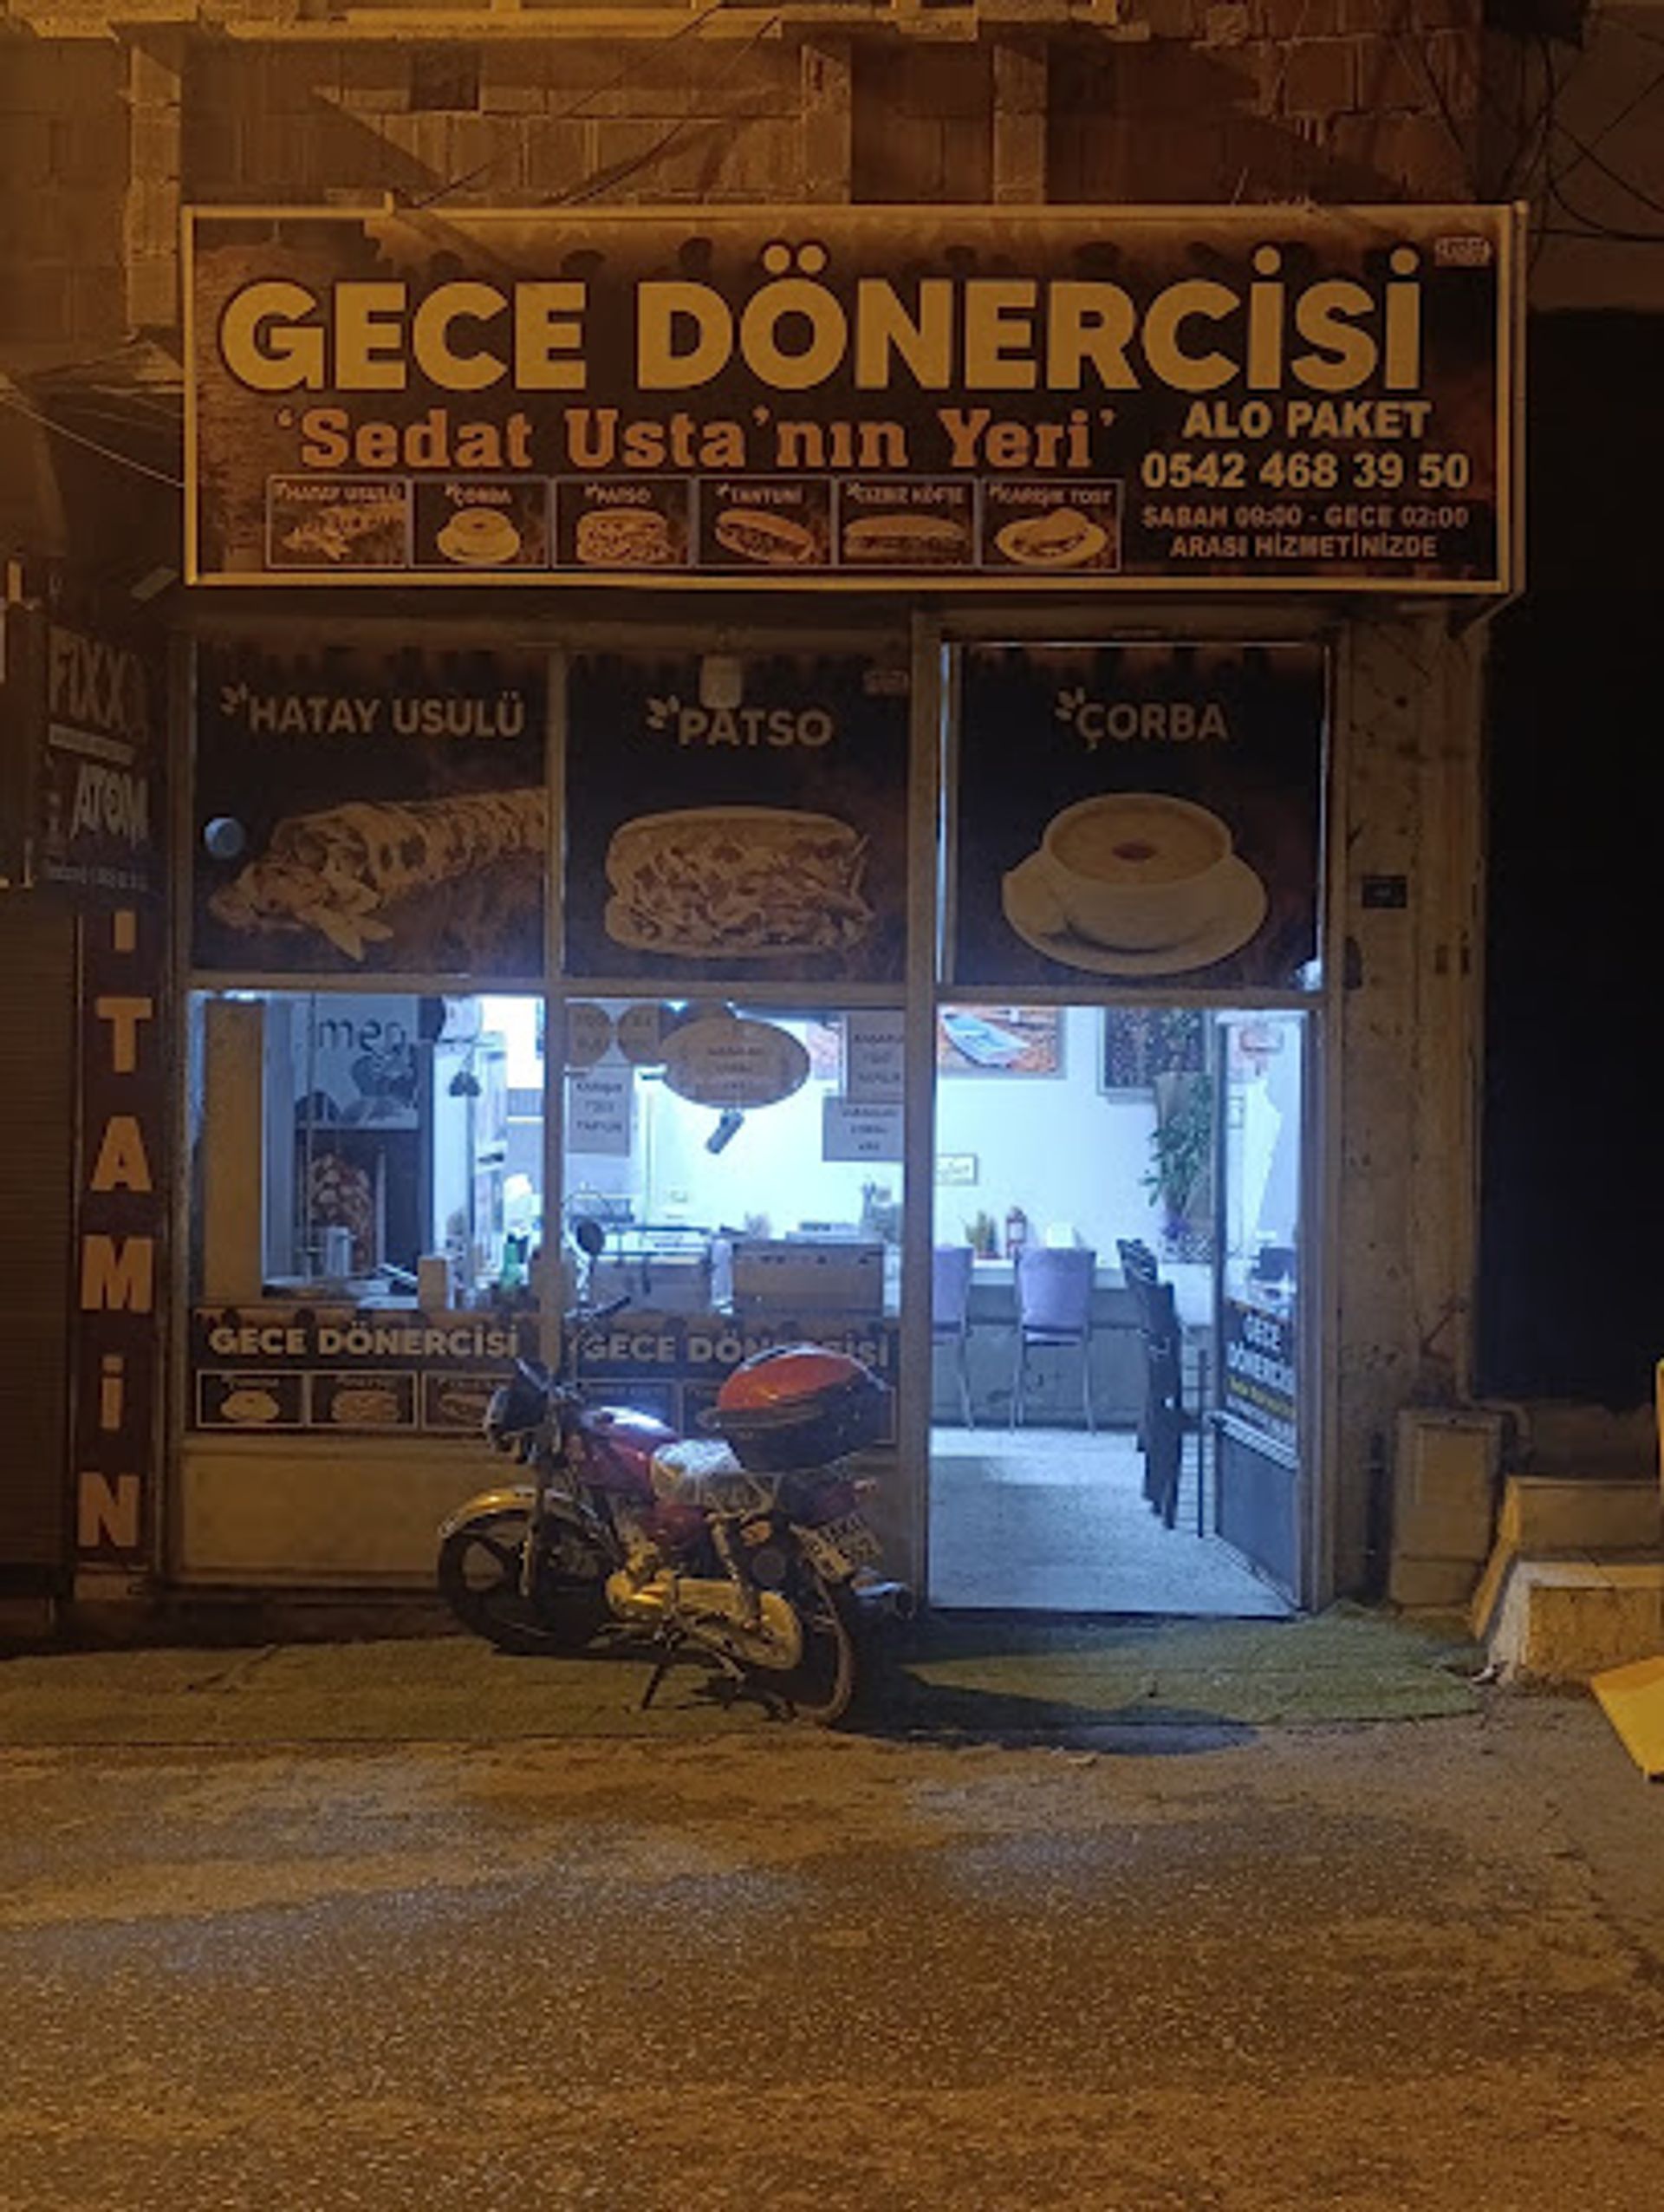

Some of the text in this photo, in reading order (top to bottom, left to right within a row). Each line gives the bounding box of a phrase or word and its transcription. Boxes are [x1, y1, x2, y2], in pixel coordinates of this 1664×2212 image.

[220, 244, 1420, 392] GECE DÖNERCİSİ
[1181, 399, 1434, 439] ALO PAKET
[1141, 451, 1471, 491] 0542 468 39 50
[1141, 504, 1229, 530] SABAH
[1323, 504, 1394, 530] GECE
[1399, 504, 1471, 530] 02:00
[1169, 530, 1439, 559] ARASI HİZMETİNİZDE
[248, 690, 524, 738] HATAY USULÜ
[678, 706, 835, 748] PATSO
[1075, 702, 1231, 752] ÇORBA
[208, 1321, 519, 1358] GECE DÖNERCİSİ
[582, 1334, 676, 1363] GECE
